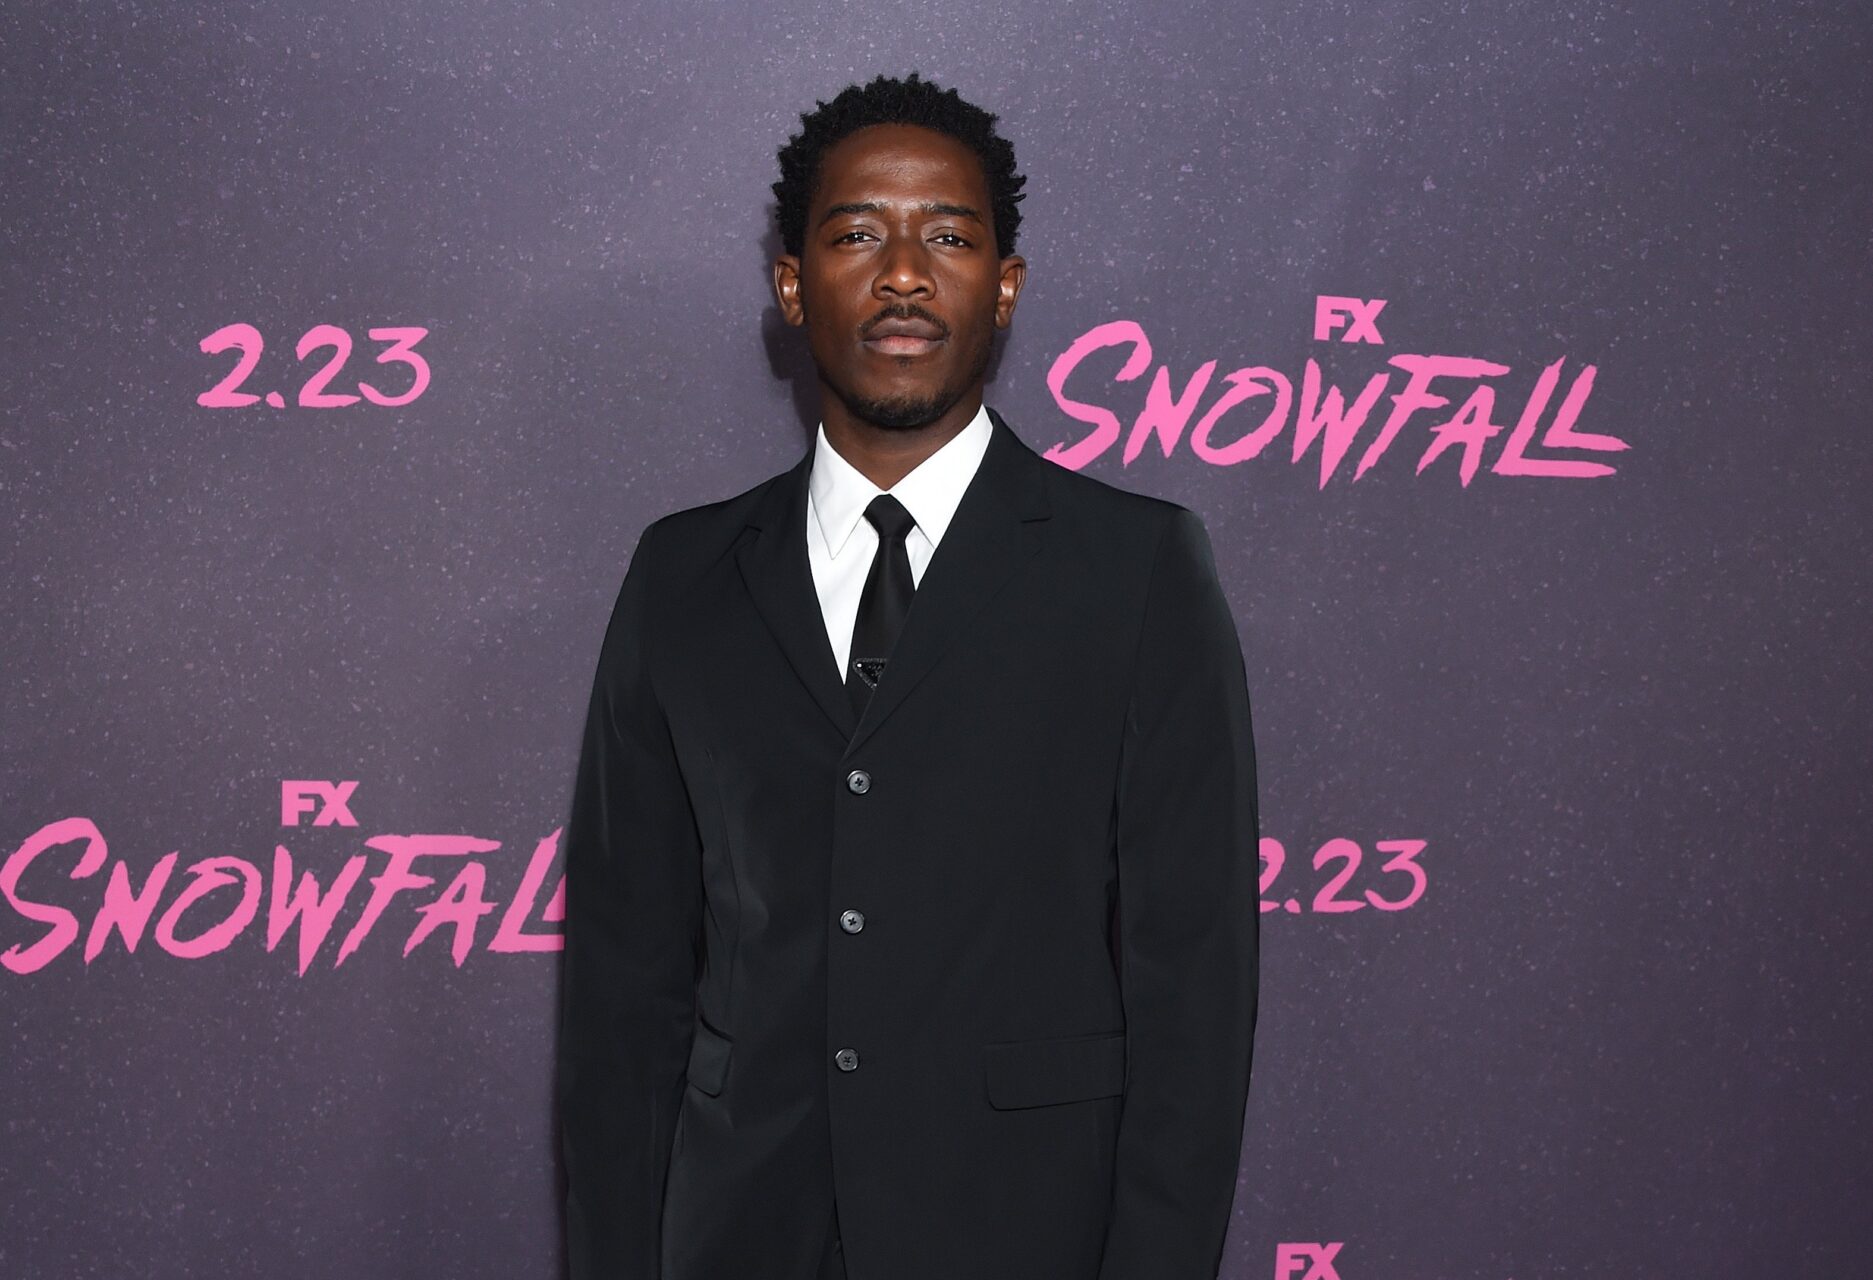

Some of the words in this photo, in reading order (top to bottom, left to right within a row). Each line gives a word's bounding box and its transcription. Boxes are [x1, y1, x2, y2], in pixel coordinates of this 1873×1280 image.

[1315, 296, 1386, 344] FX
[197, 324, 430, 408] 2.23
[1044, 321, 1629, 487] SNOWFALL
[281, 780, 357, 826] FX
[0, 818, 564, 976] SNOWFAL
